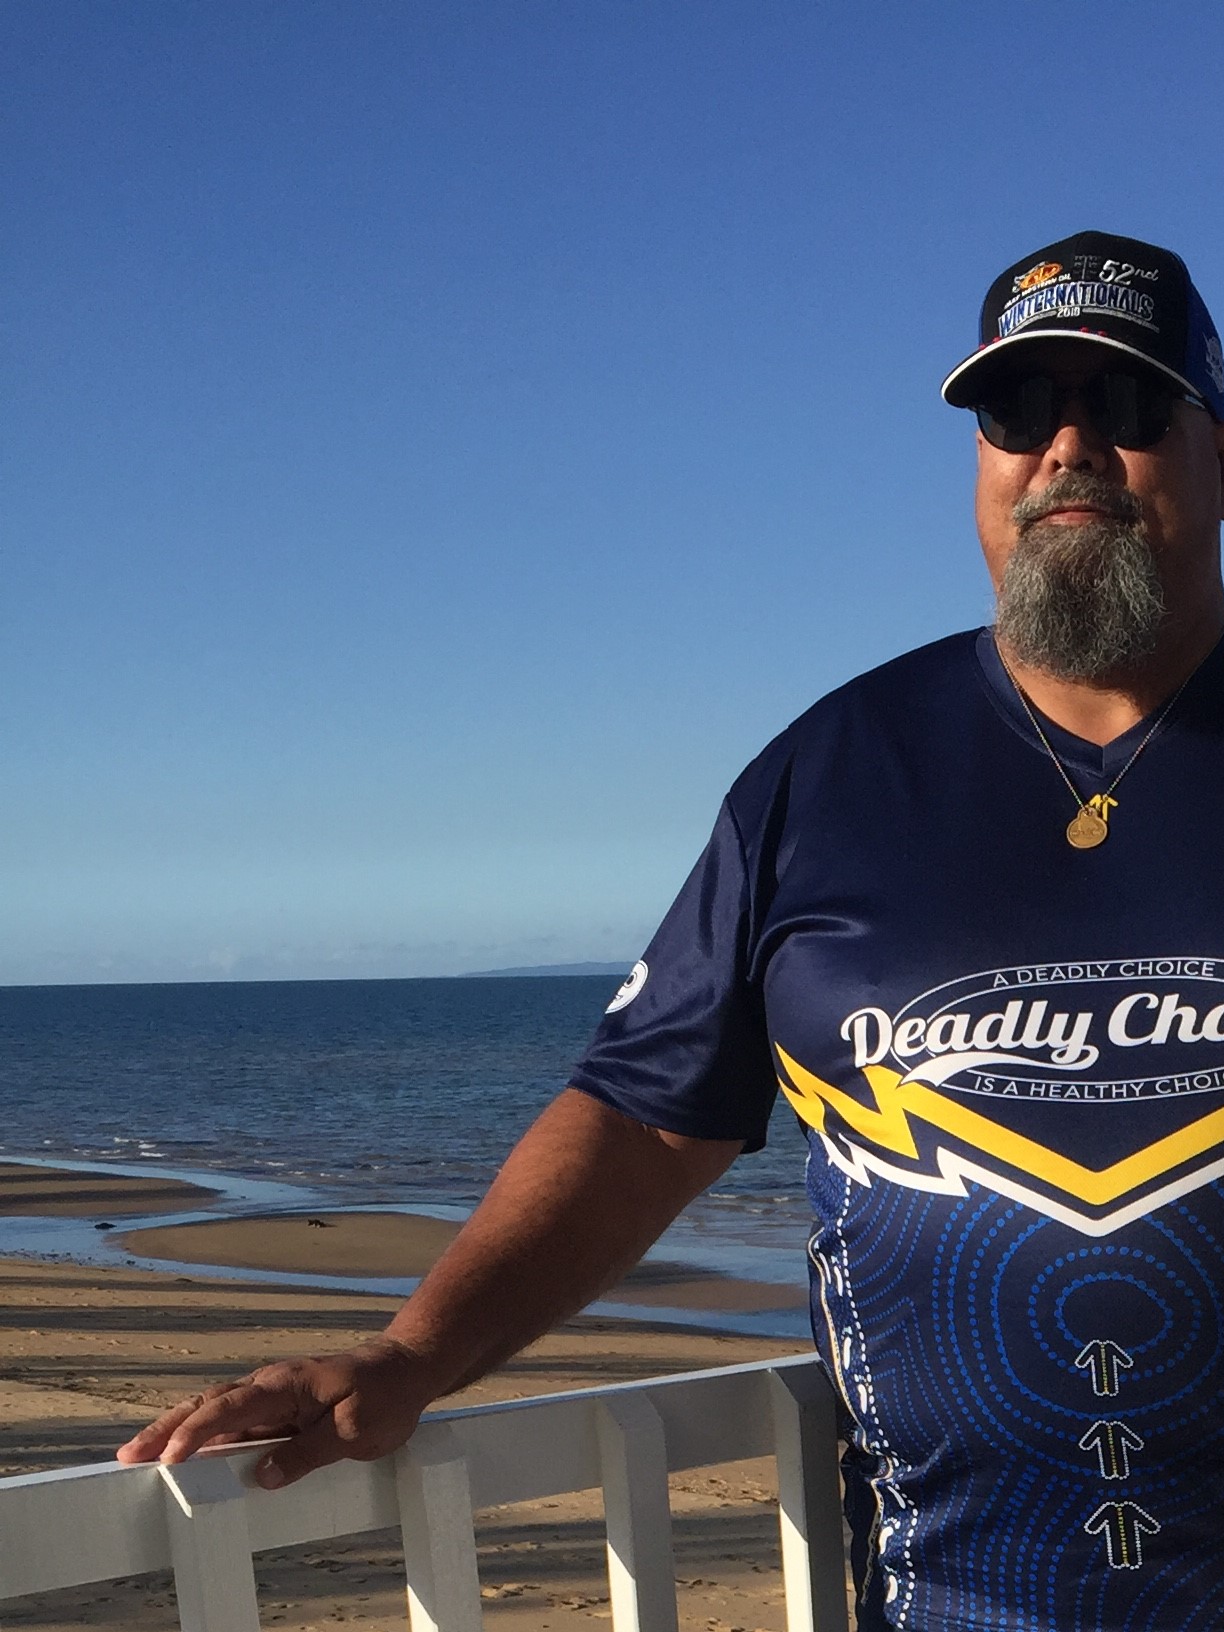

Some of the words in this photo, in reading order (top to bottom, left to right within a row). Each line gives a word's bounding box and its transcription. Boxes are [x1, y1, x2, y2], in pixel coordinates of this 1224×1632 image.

[1099, 259, 1159, 285] 52nd
[998, 281, 1153, 338] WINTERNATIONALS
[992, 973, 1009, 988] A
[1016, 963, 1110, 985] DEADLY
[1119, 960, 1217, 978] CHOICE
[840, 1000, 1100, 1087] Deadly
[974, 1075, 996, 1093] IS
[1002, 1080, 1020, 1096] A
[1029, 1080, 1145, 1100] HEALTHY
